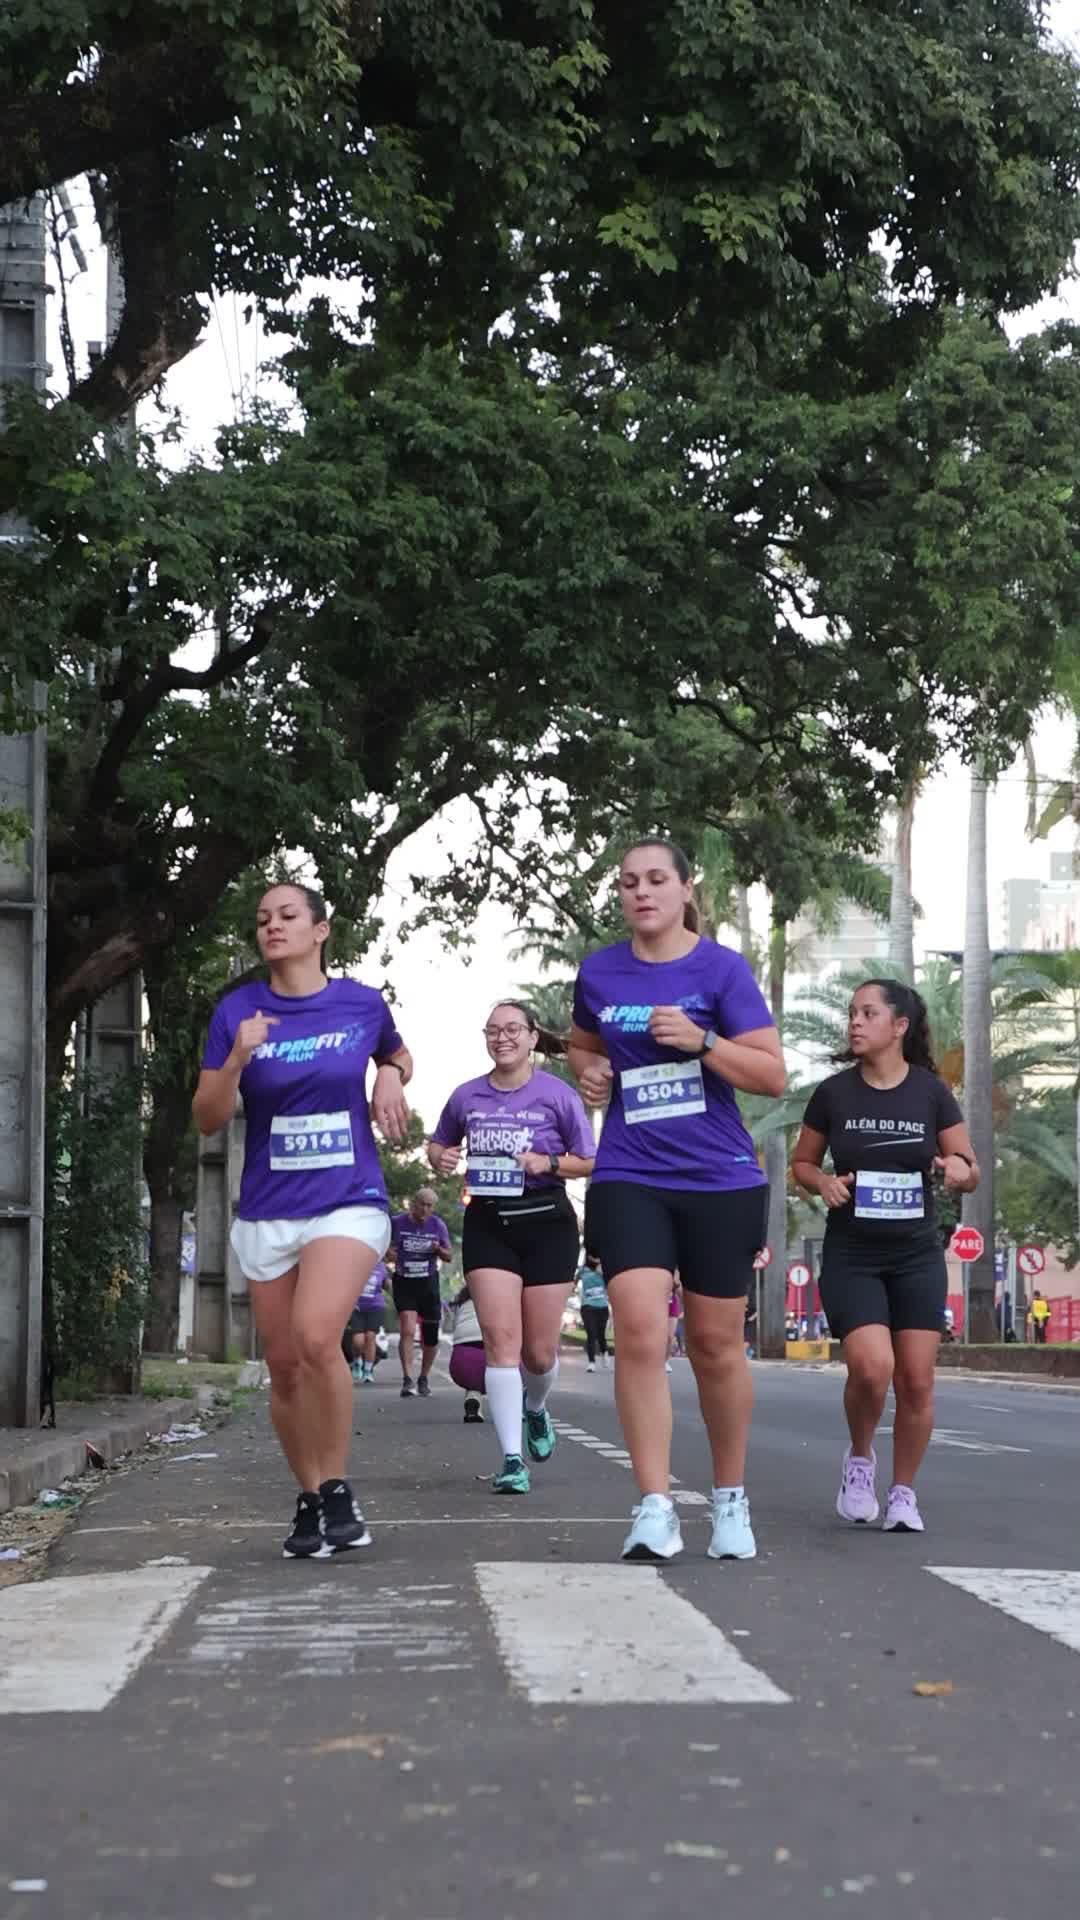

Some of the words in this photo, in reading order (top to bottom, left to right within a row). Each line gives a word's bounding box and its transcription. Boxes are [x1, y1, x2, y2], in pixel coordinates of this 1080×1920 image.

[621, 1023, 649, 1033] RUN
[286, 1050, 315, 1063] RUN
[637, 1081, 686, 1103] 6504
[844, 1117, 876, 1130] ALÉM
[879, 1119, 895, 1130] DO
[898, 1120, 925, 1134] PACE
[284, 1132, 334, 1152] 5914
[478, 1170, 511, 1183] 5315
[871, 1188, 914, 1204] 5015
[953, 1239, 981, 1250] PARE
